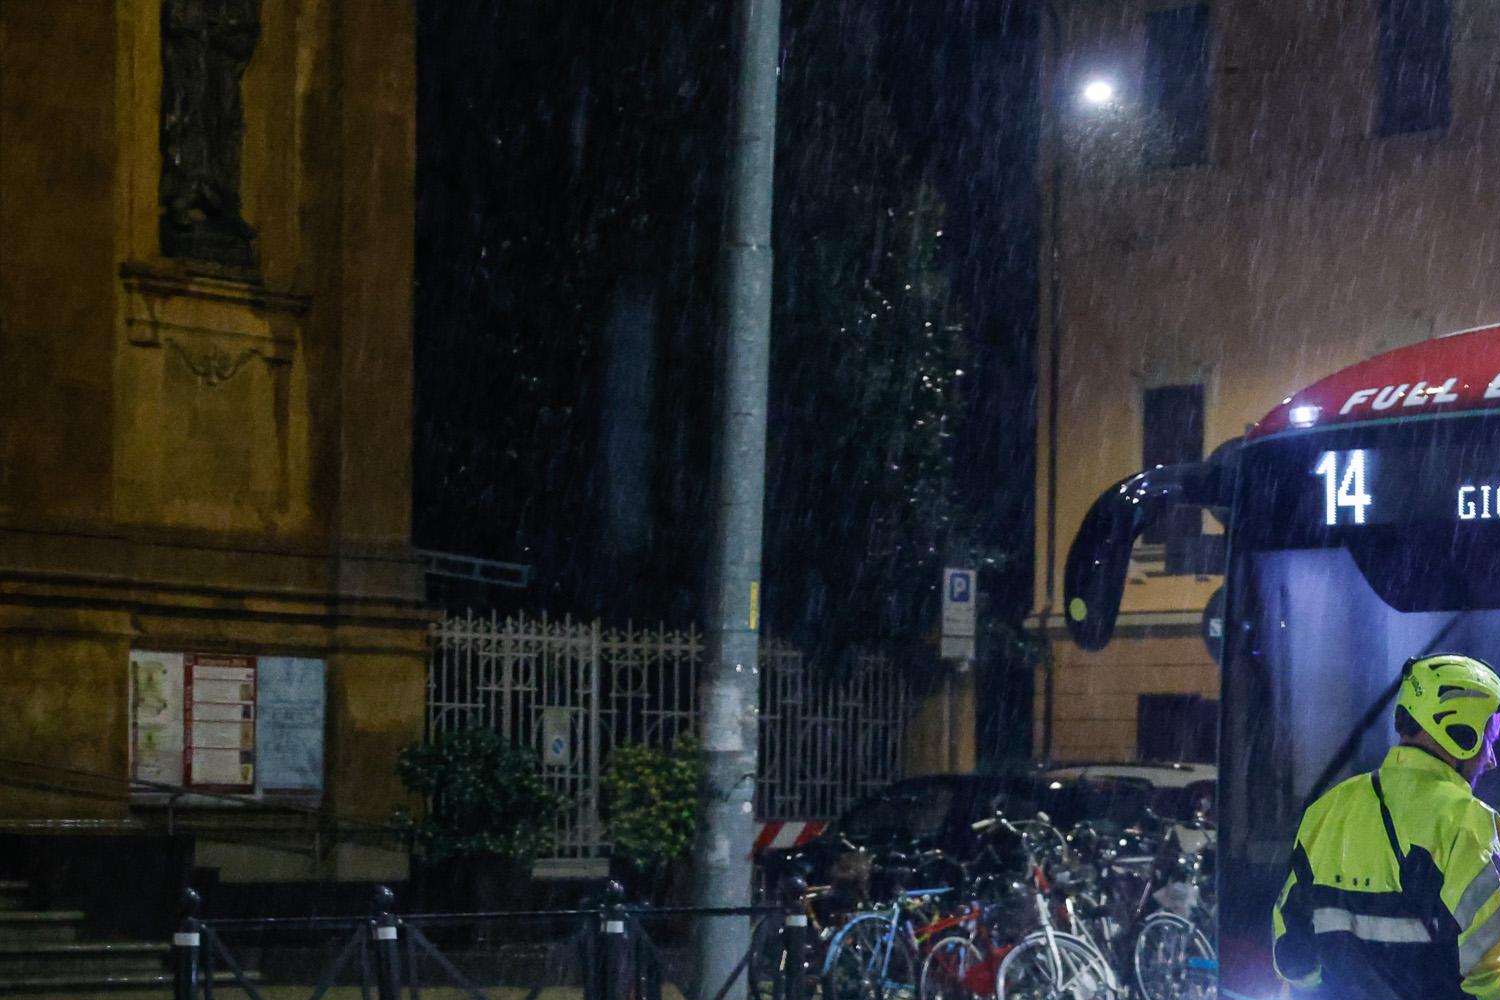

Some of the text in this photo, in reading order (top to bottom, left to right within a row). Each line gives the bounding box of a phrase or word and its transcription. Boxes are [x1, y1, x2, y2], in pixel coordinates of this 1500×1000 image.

[1339, 378, 1460, 415] FULL
[1315, 449, 1372, 525] 14
[953, 577, 966, 600] P
